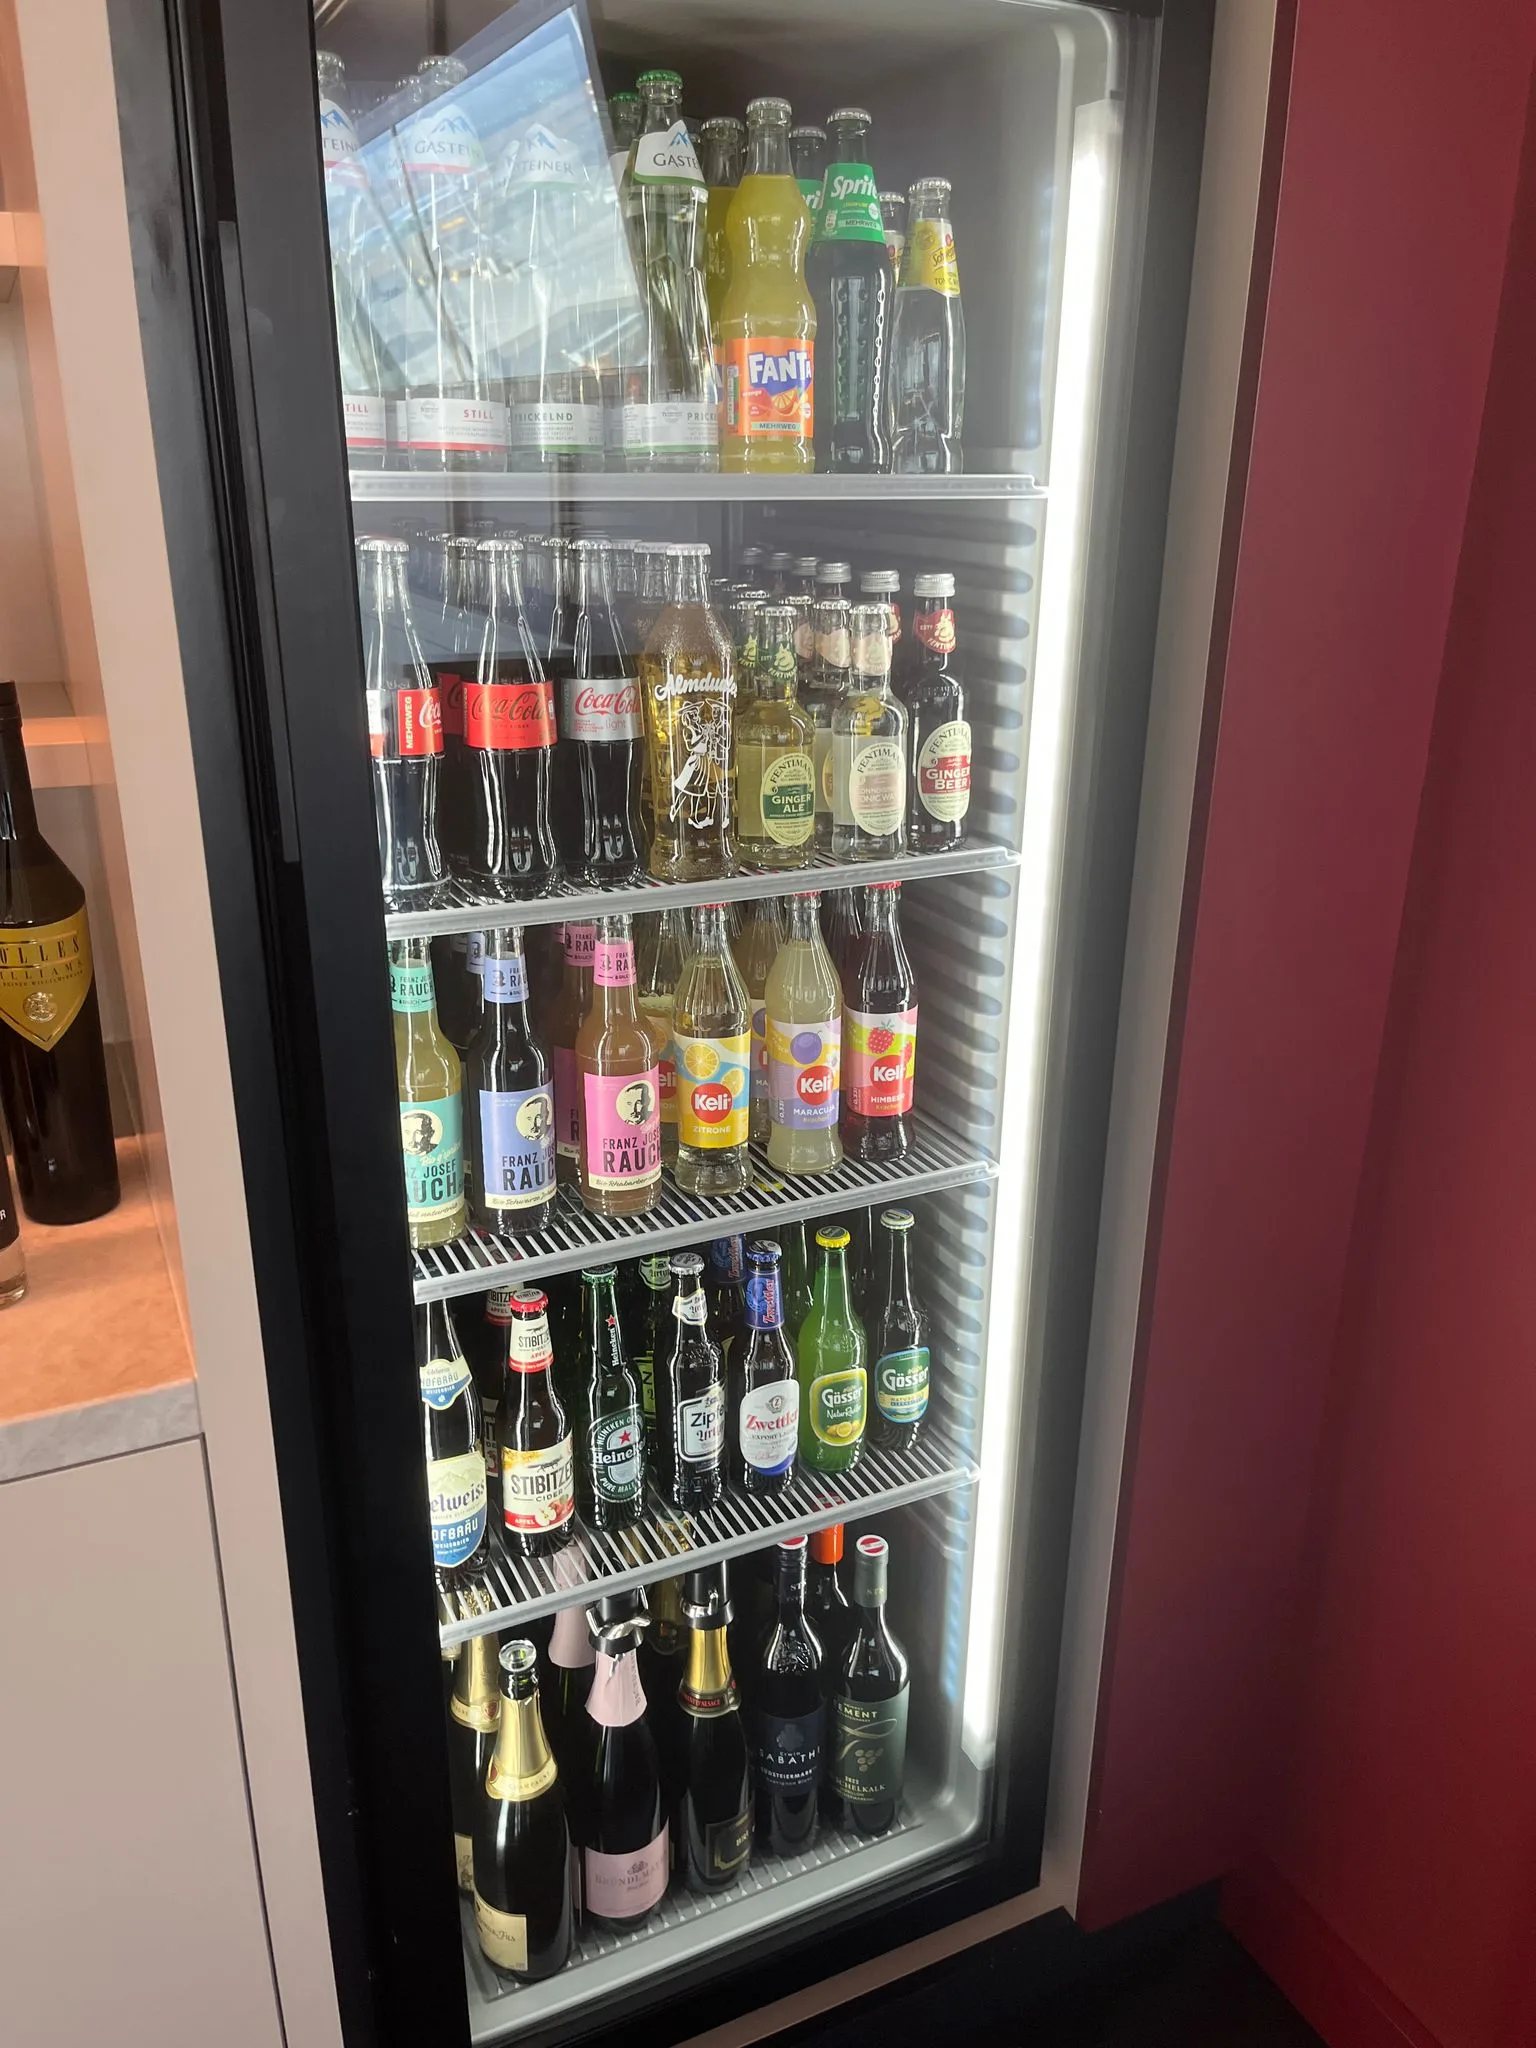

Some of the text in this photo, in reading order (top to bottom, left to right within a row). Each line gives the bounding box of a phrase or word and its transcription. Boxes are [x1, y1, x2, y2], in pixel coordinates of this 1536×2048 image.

[748, 351, 812, 385] FANTA
[463, 409, 495, 420] STILL
[759, 423, 797, 431] MEHRWEG
[405, 696, 414, 749] MEHRWEG
[605, 717, 626, 731] light
[935, 778, 968, 790] BEER
[772, 794, 812, 805] GINGER
[783, 803, 805, 814] ALE
[801, 1075, 833, 1094] Keli
[695, 1093, 729, 1111] Keli
[693, 1126, 731, 1135] ZITRONE
[602, 1137, 638, 1150] FRANZ
[502, 1152, 538, 1167] FRANZ
[423, 1159, 456, 1179] JOSEF
[763, 1280, 775, 1324] Zwettler
[608, 1326, 620, 1367] Heineken
[883, 1367, 929, 1391] Gösser
[822, 1386, 862, 1408] Gösser
[597, 1419, 625, 1446] HEINEKEN
[601, 1477, 617, 1492] PURE
[536, 1490, 563, 1502] CIDER
